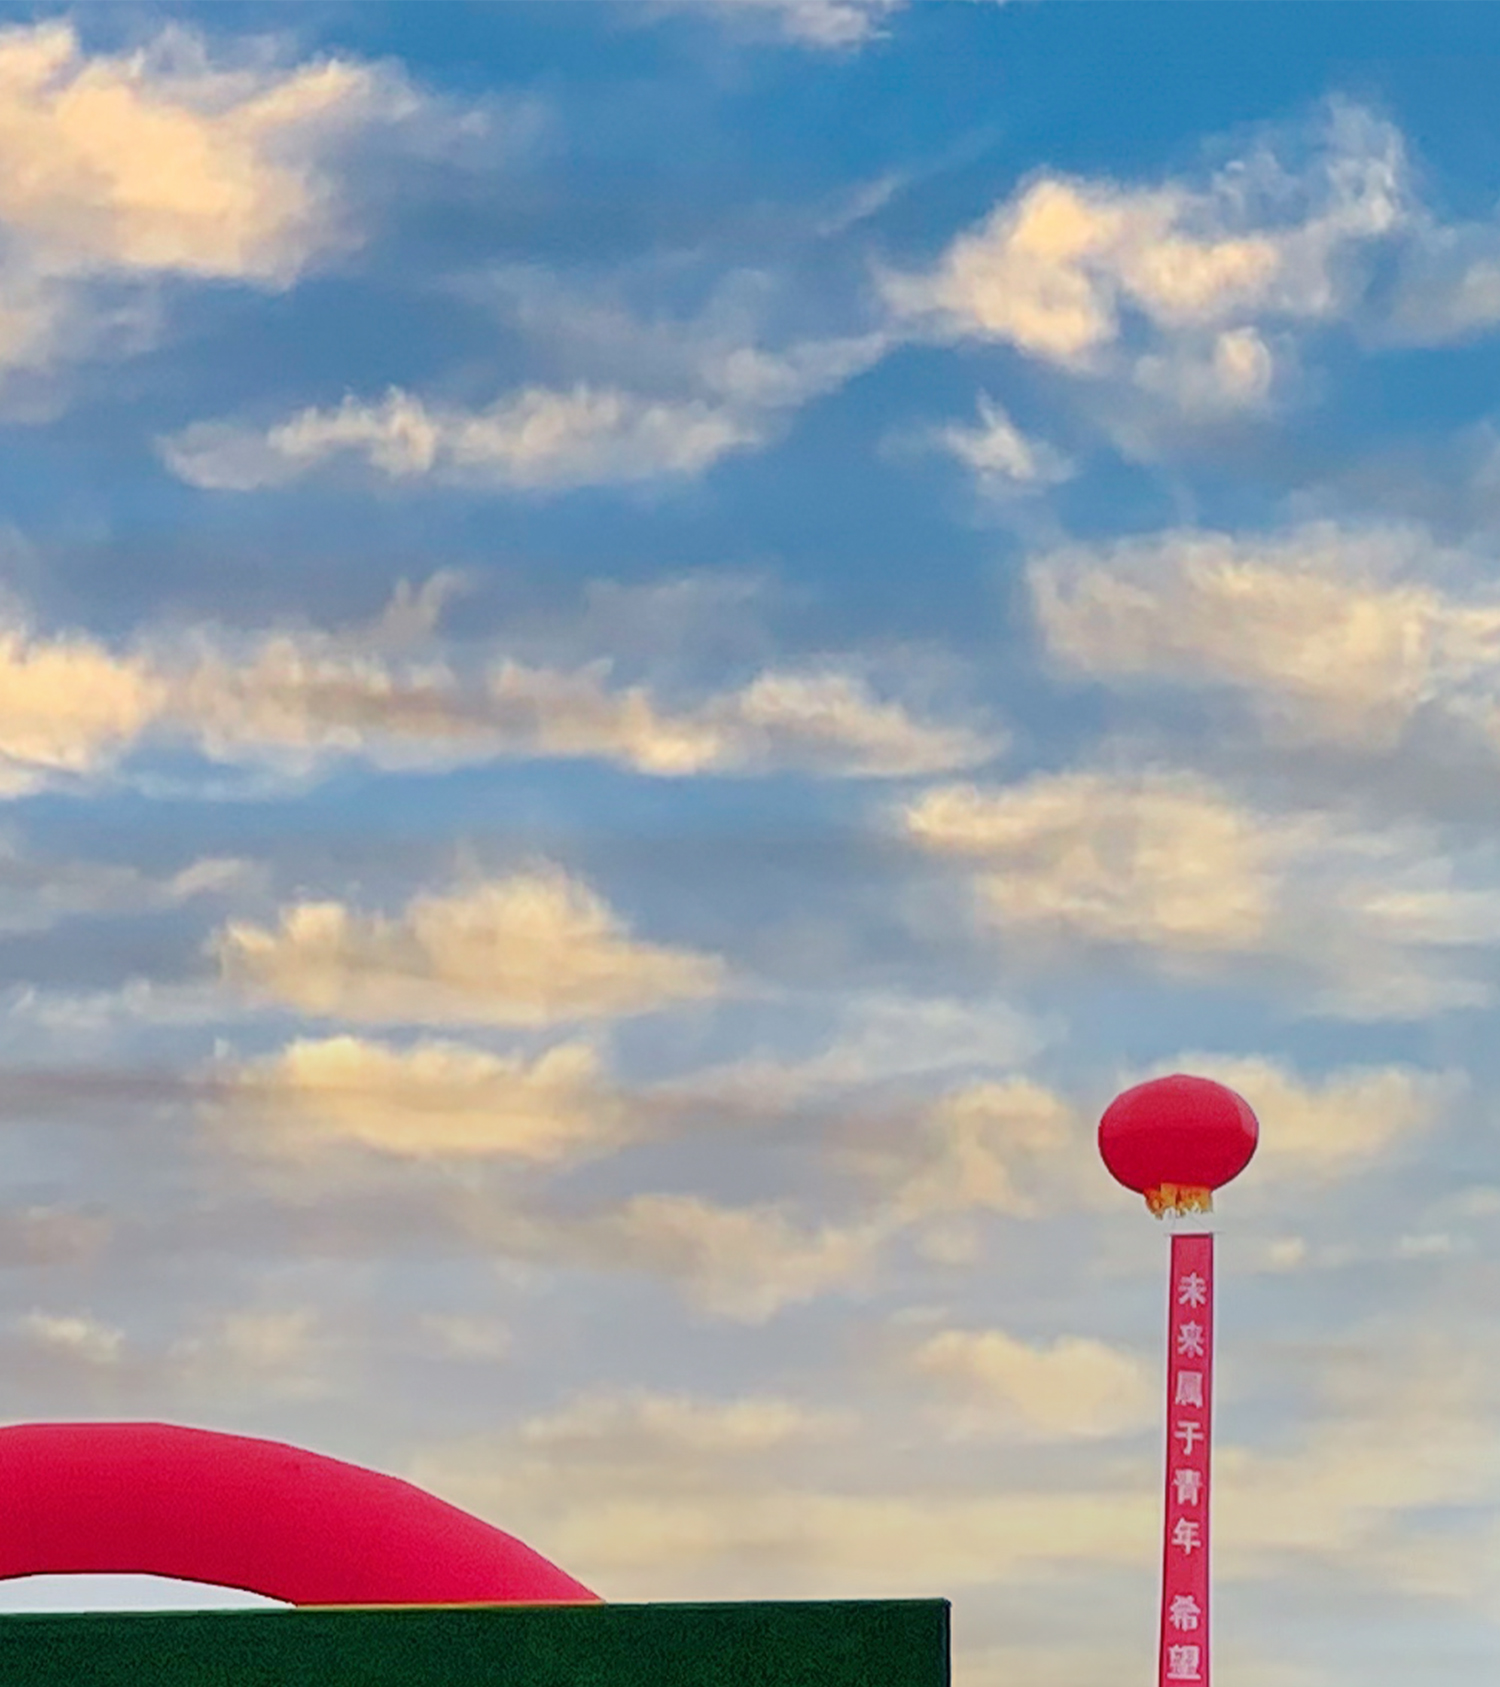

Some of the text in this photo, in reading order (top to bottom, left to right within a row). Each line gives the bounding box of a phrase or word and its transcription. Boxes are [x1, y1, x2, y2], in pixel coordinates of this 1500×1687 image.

[1171, 1272, 1207, 1555] 未来属于青年
